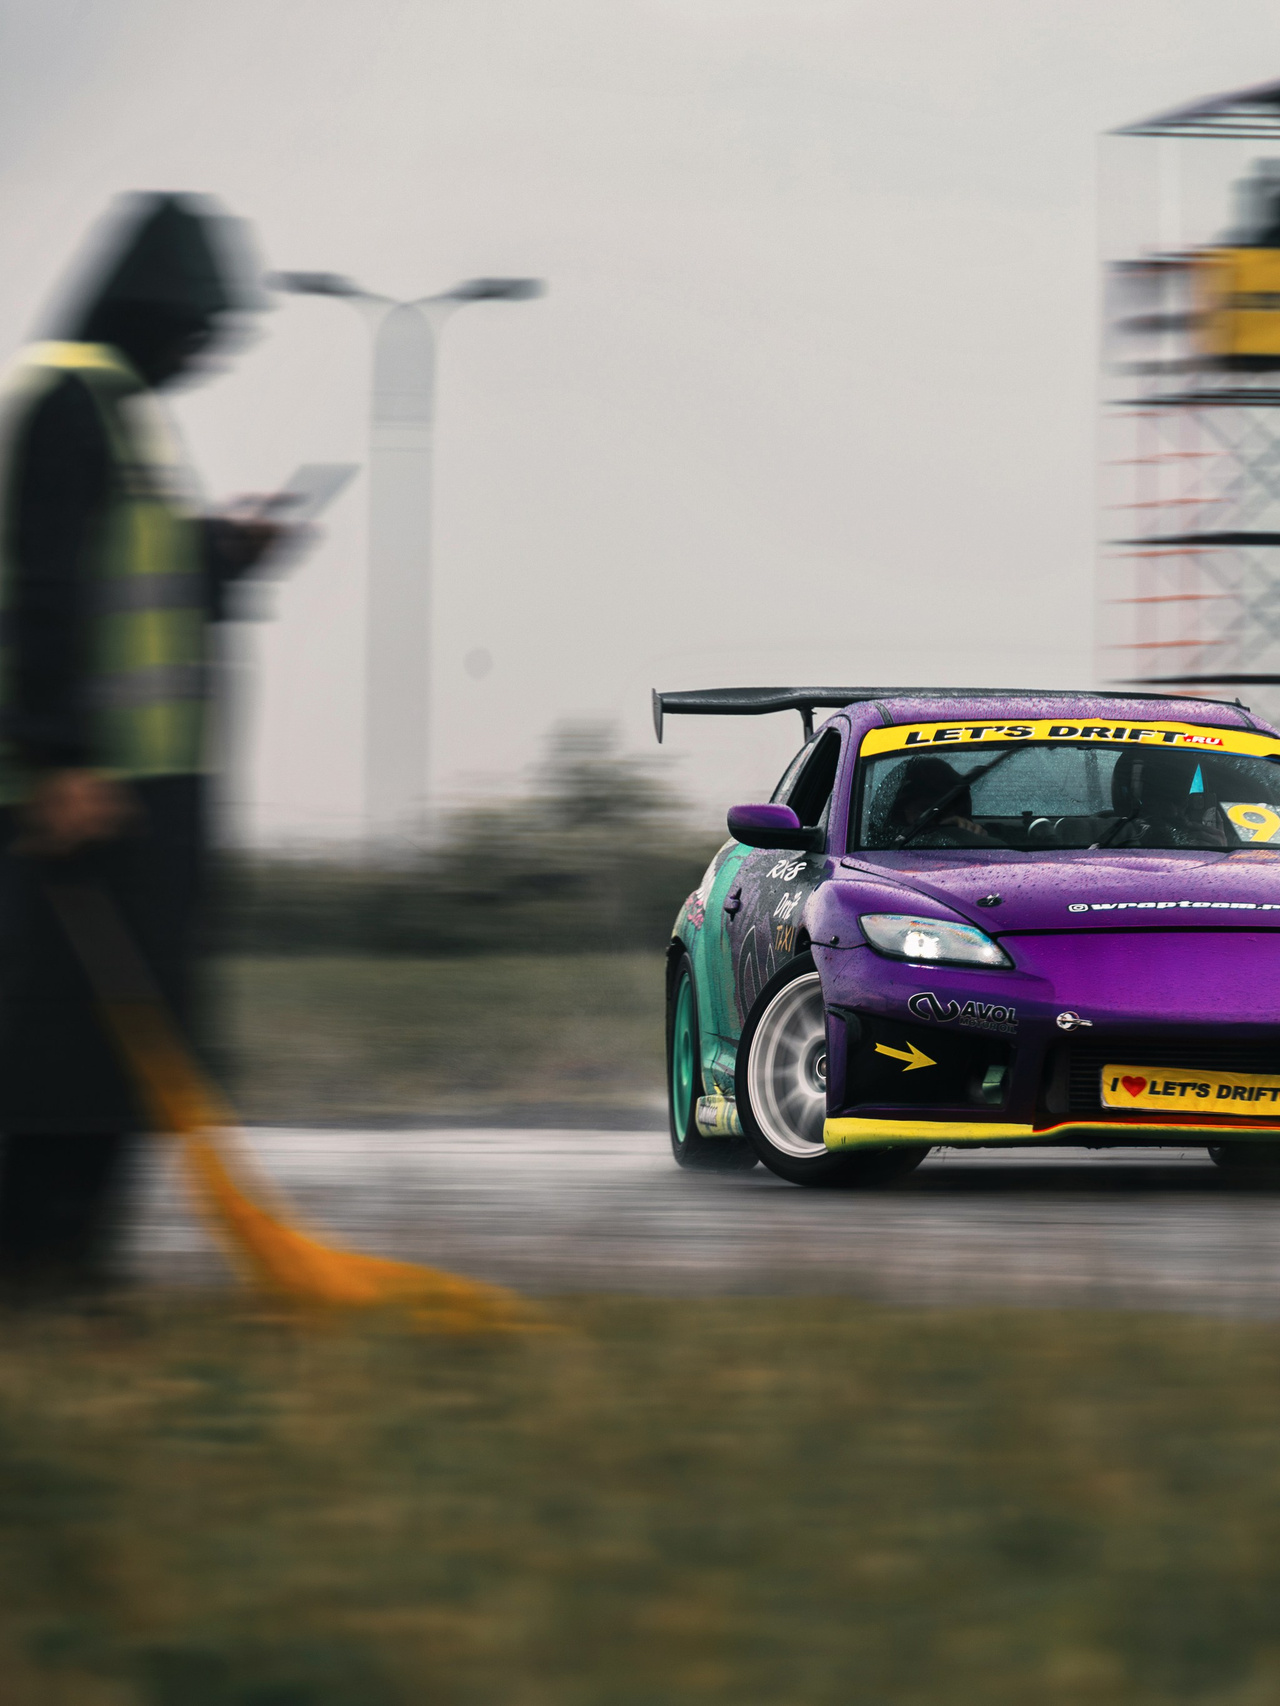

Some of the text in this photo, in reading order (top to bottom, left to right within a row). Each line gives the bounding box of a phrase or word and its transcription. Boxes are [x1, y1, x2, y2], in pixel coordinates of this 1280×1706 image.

[905, 726, 1035, 745] LET'S
[960, 1000, 1019, 1026] AVOL
[1110, 1077, 1120, 1092] I
[1148, 1080, 1211, 1099] LET'S
